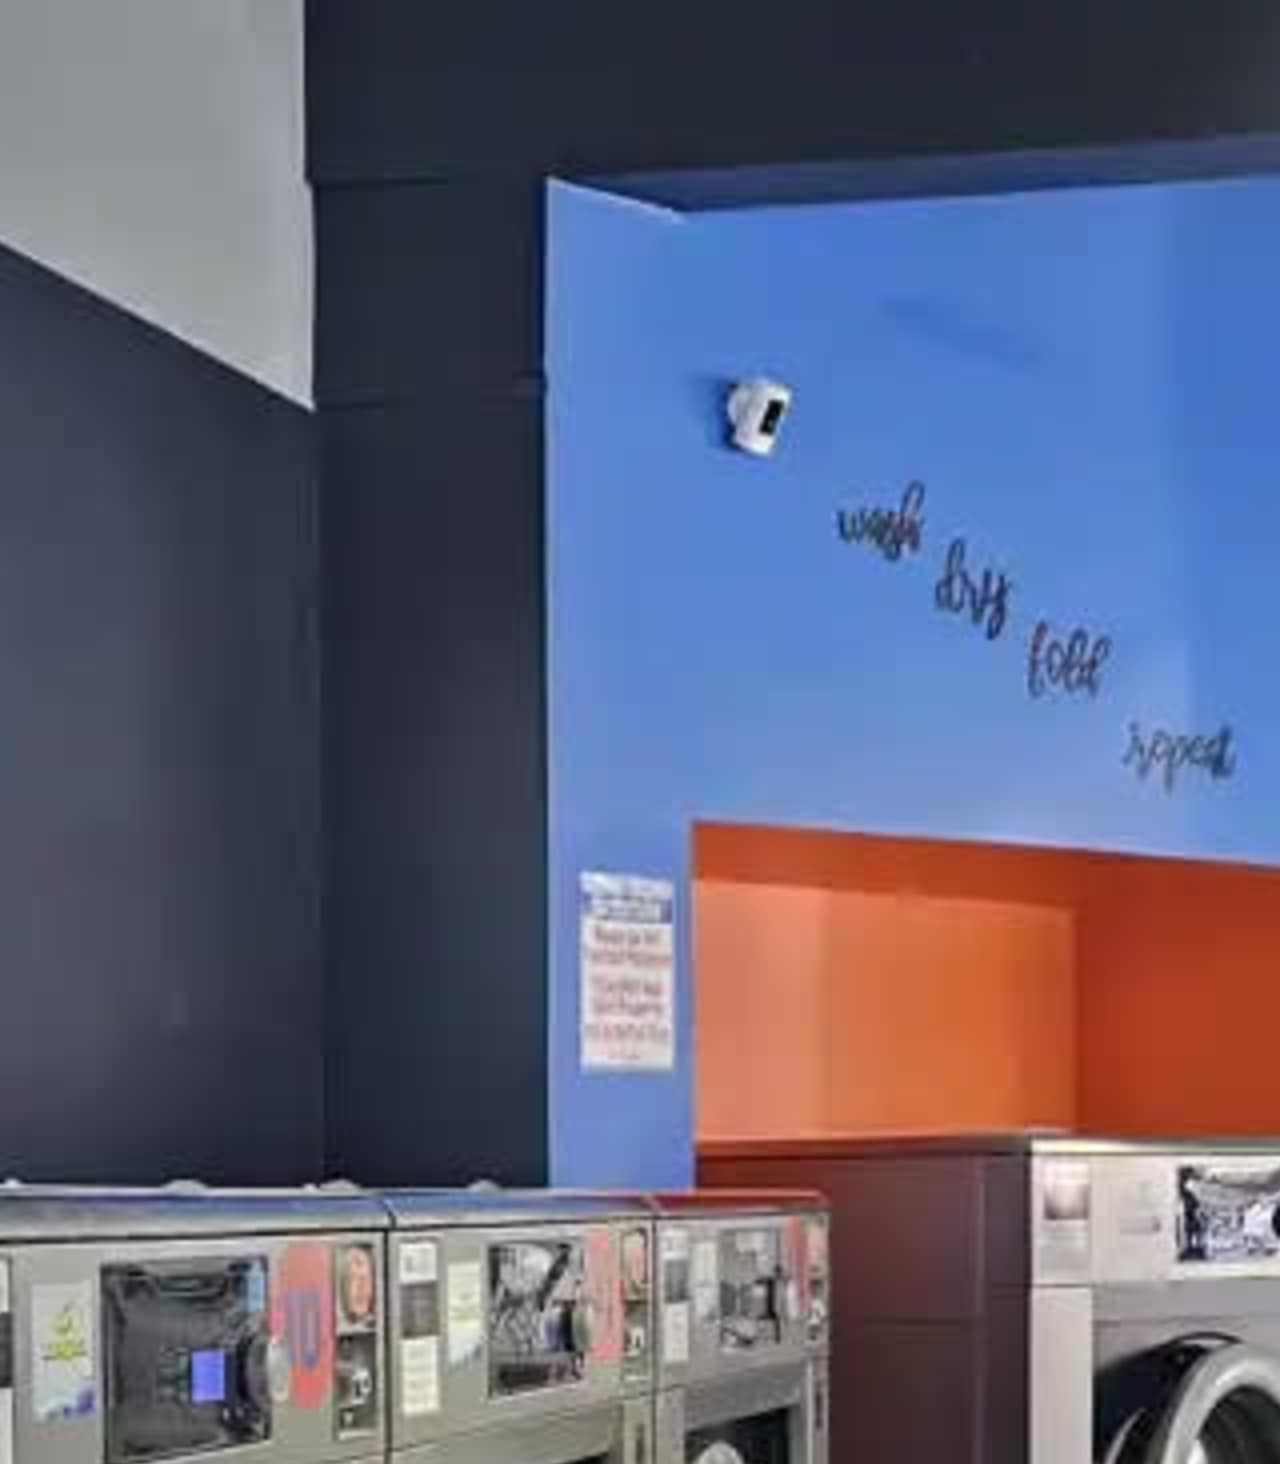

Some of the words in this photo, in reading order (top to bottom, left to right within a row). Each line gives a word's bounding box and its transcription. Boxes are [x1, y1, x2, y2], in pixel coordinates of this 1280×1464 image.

[837, 480, 925, 562] wash
[934, 538, 1012, 640] dry
[1028, 620, 1113, 699] fold
